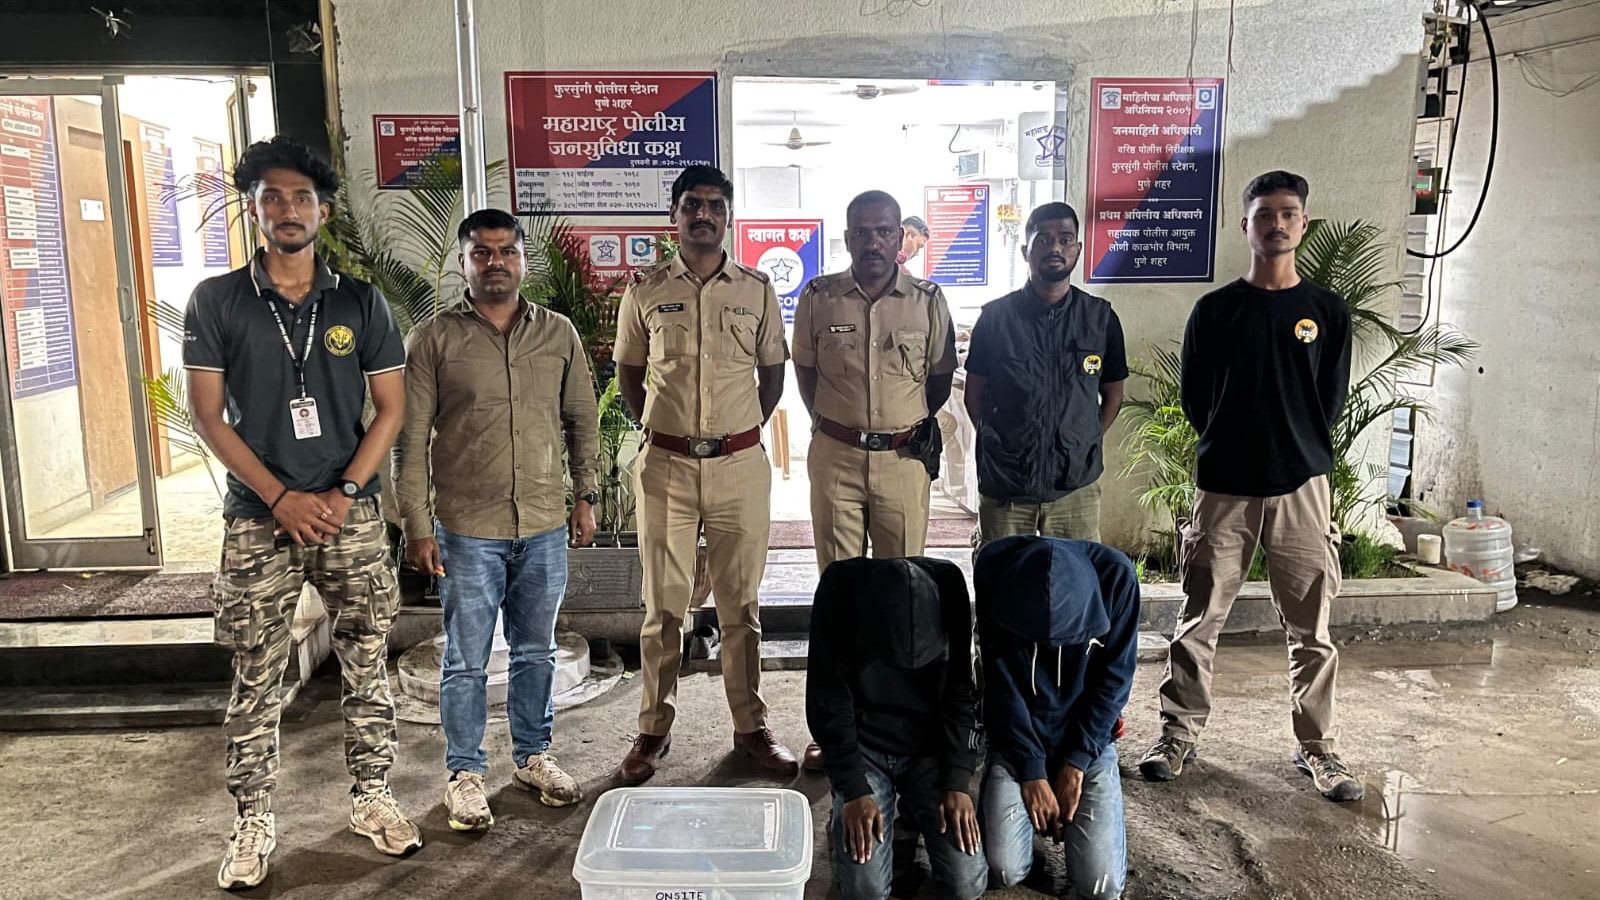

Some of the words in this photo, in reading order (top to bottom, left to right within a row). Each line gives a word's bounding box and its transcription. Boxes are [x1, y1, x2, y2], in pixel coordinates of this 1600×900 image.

[554, 83, 592, 98] फुरसुंगी
[594, 82, 627, 95] पोलीस
[630, 82, 659, 95] स्टेशन
[1122, 92, 1160, 103] माहितीचा
[594, 97, 610, 112] पुणे
[612, 98, 632, 109] शहर
[1124, 104, 1164, 114] अधिनियम
[1166, 106, 1191, 116] २००५
[542, 116, 618, 136] महाराष्ट्र
[622, 111, 686, 132] पोलीस
[1112, 124, 1160, 137] जनमाहिती
[1162, 124, 1202, 136] अधिकारी
[548, 137, 640, 162] जनसुविधा
[644, 141, 682, 158] कक्ष
[1118, 144, 1136, 154] वरिष्ठ
[1139, 144, 1162, 154] पोलीस
[1166, 144, 1195, 154] निरीक्षक
[1112, 160, 1140, 174] फुरसुंगी
[1142, 160, 1168, 171] पोलीस
[1172, 162, 1198, 172] स्टेशन,
[1138, 178, 1151, 190] पुणे
[1154, 180, 1172, 189] शहर
[1100, 210, 1121, 220] प्रथम
[1124, 208, 1160, 220] अपिलीय
[1163, 208, 1202, 220] अधिकारी
[747, 228, 786, 242] स्वागत
[788, 228, 811, 244] कक्ष
[1107, 229, 1140, 238] सहाय्यक
[1143, 226, 1168, 238] पोलीस
[1172, 228, 1196, 239] आयुक्त
[1108, 240, 1128, 252] लोणी
[1132, 240, 1164, 252] काळभोर
[1134, 255, 1148, 268] पुणे
[1150, 258, 1168, 266] शहर
[656, 892, 704, 900] ONSITE
